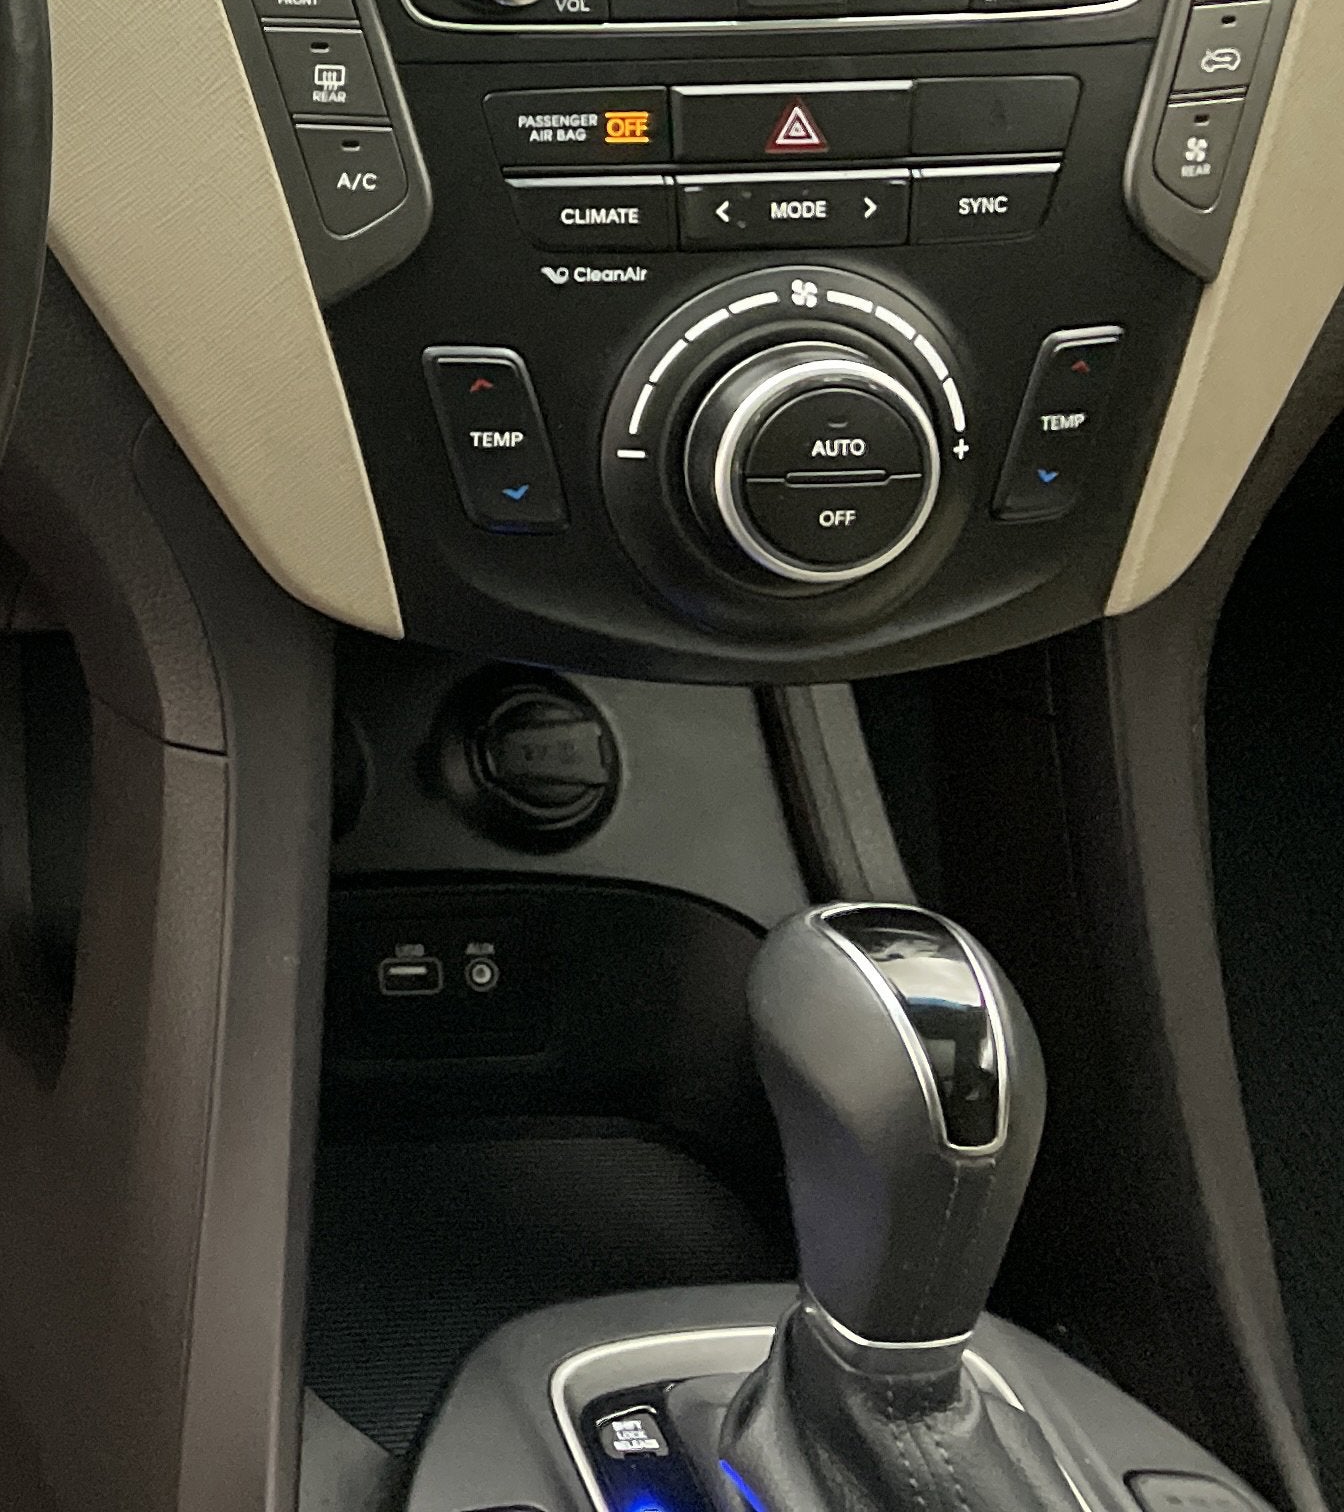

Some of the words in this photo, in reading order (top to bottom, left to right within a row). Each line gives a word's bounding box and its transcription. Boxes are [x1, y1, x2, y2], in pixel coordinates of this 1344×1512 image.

[313, 91, 346, 103] REAR
[518, 113, 598, 129] PASSENGER
[606, 117, 647, 138] OFF
[529, 128, 552, 142] AIR
[556, 128, 586, 142] BAG
[337, 172, 377, 191] A/C
[770, 201, 827, 219] MODE
[958, 196, 1009, 215] SYNC
[560, 208, 639, 225] CLIMATE
[573, 265, 647, 283] CleanAir
[1040, 414, 1086, 433] TEMP
[469, 430, 525, 449] TEMP
[811, 439, 866, 459] AUTO
[818, 509, 857, 529] OFF
